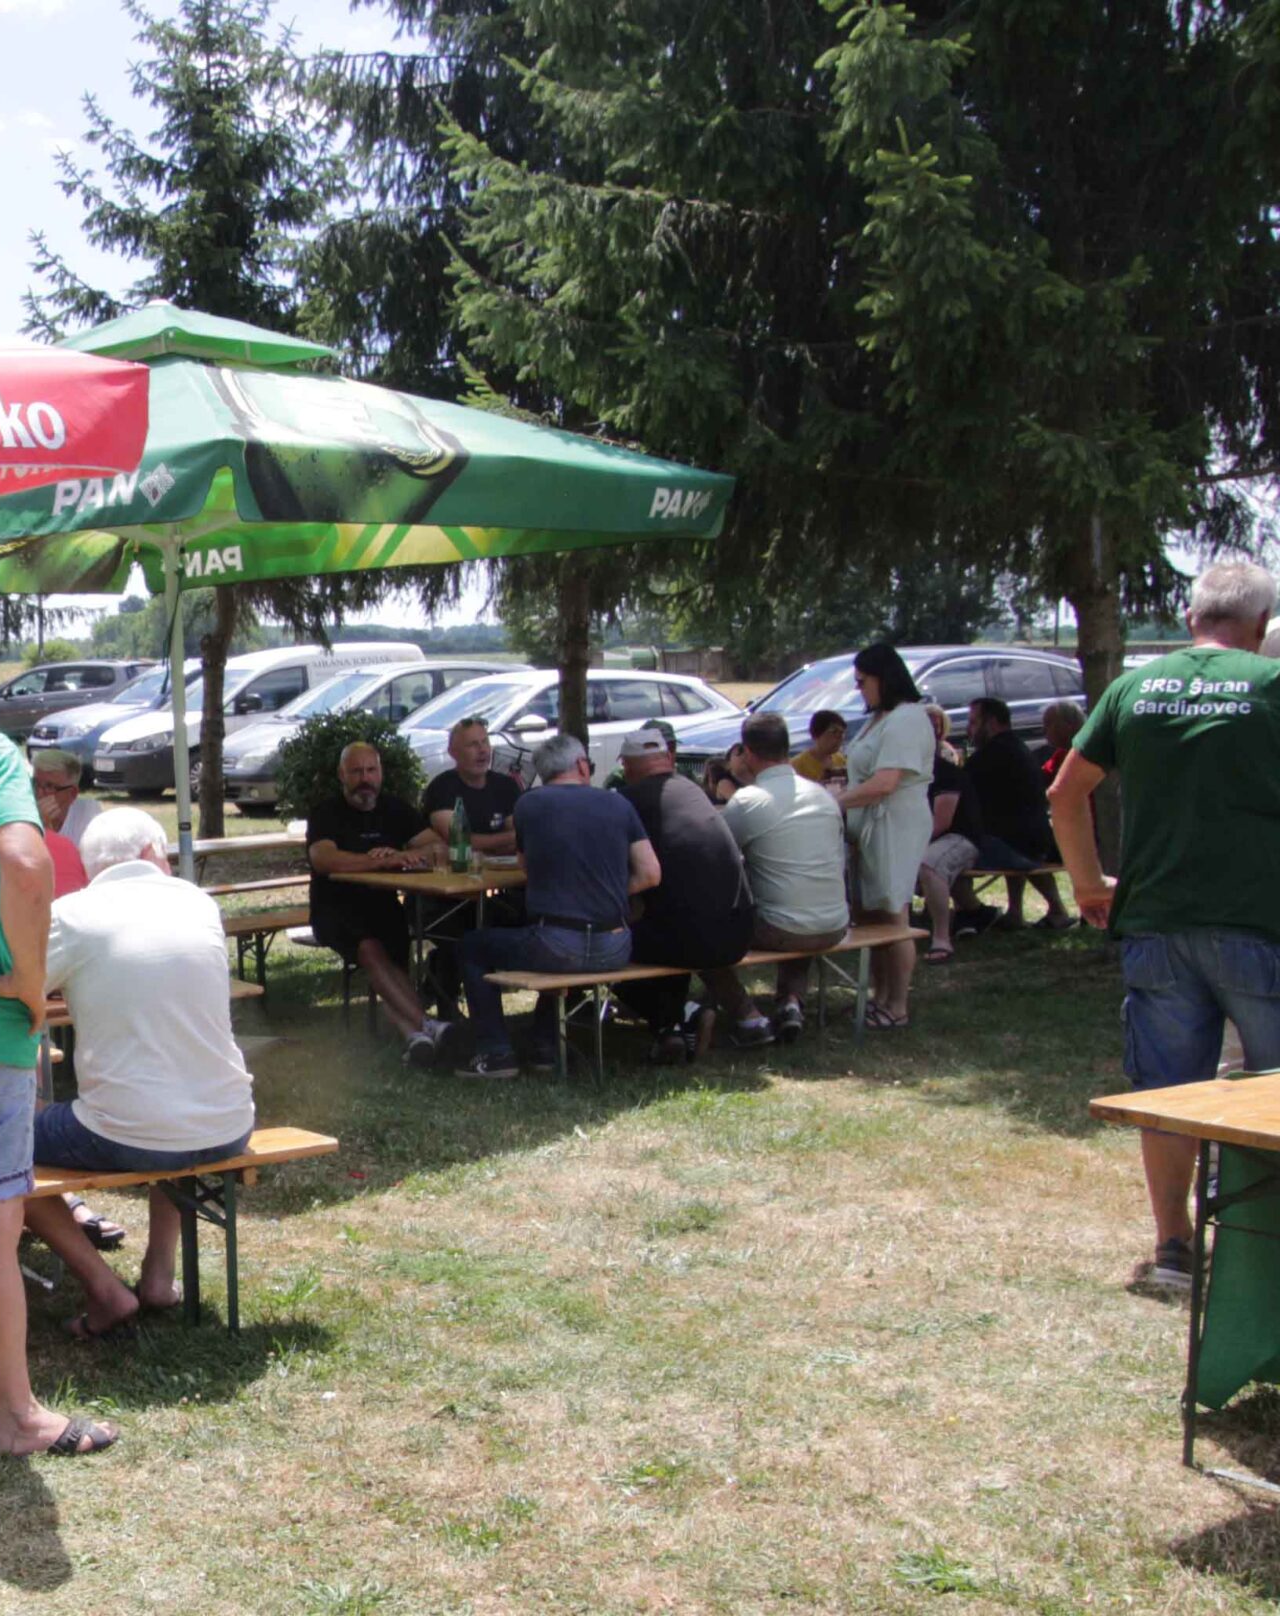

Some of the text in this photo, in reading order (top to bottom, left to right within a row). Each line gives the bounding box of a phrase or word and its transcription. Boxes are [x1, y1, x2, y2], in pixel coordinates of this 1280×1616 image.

[52, 468, 140, 517] PAN
[1140, 679, 1182, 694] SRD
[1133, 699, 1251, 715] Gardinovec
